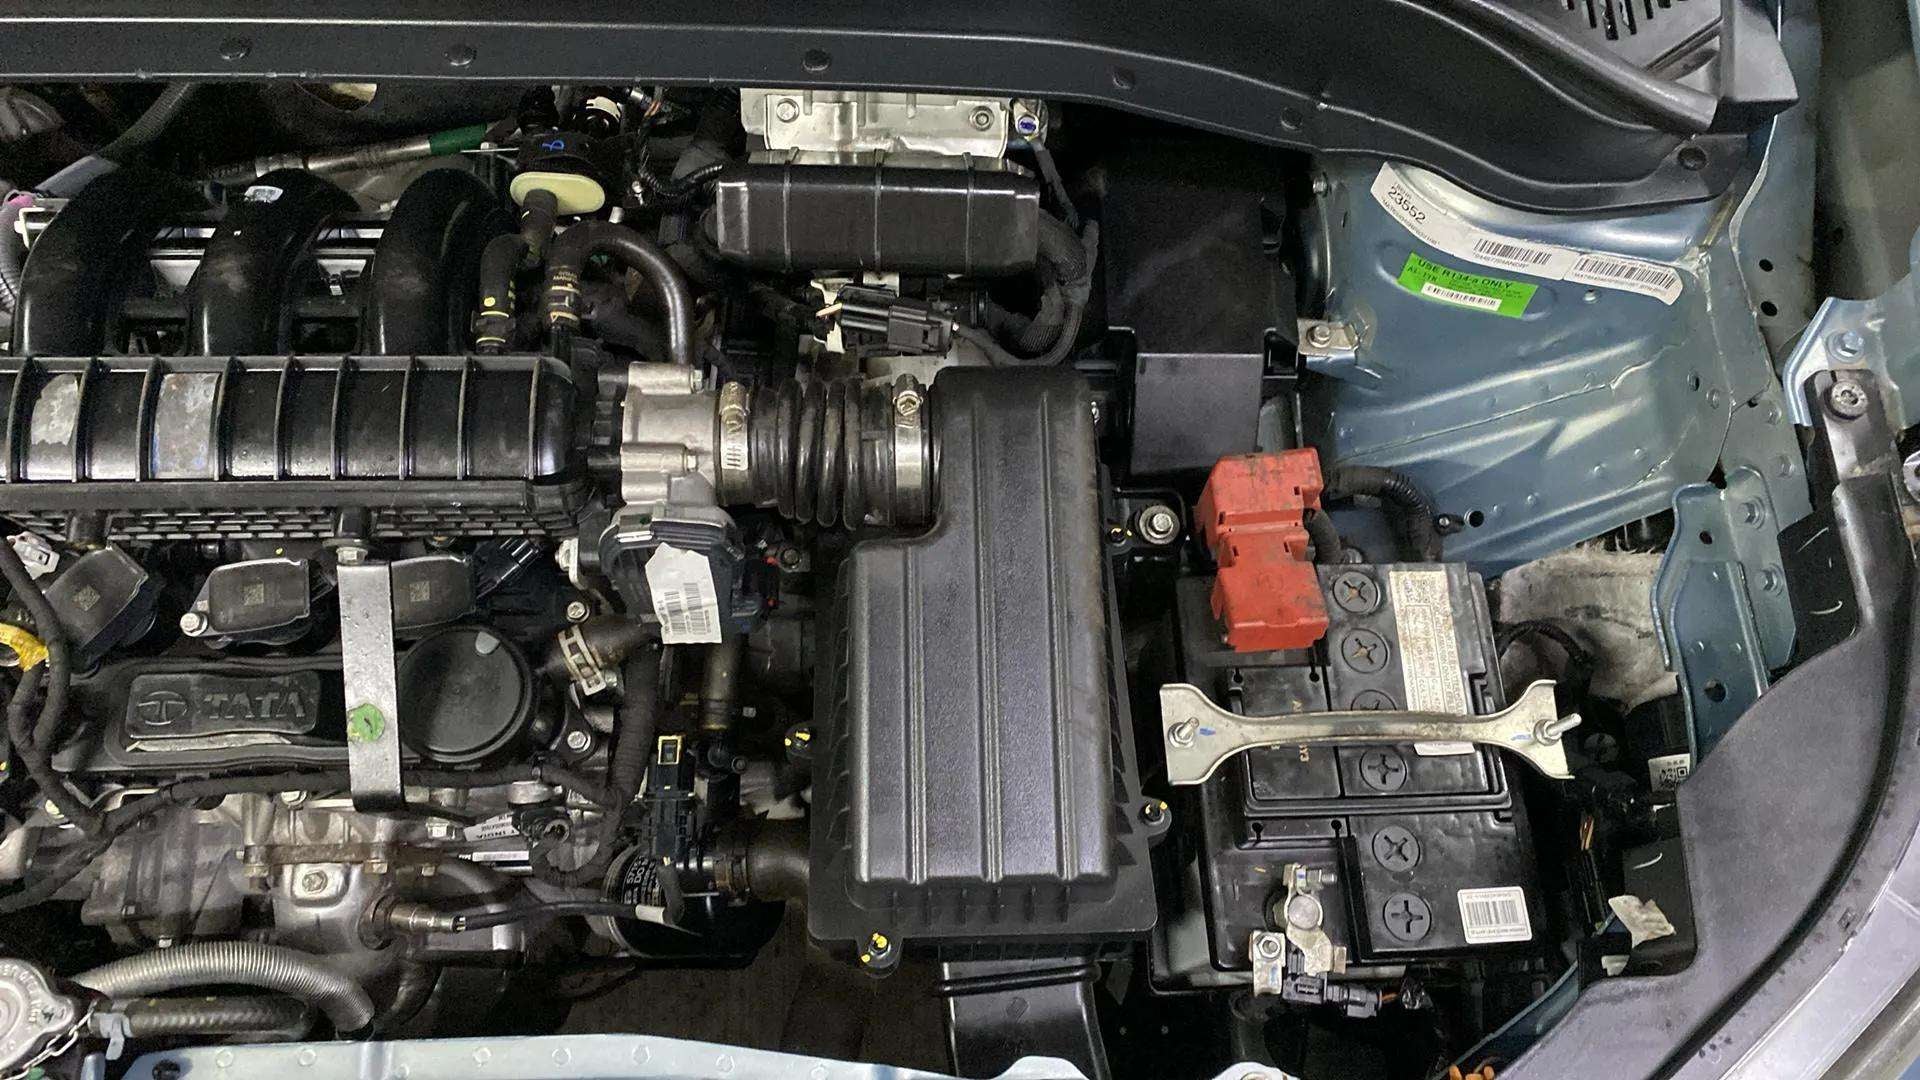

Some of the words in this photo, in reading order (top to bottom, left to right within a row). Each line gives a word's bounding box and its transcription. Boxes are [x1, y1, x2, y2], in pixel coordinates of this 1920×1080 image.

[1387, 186, 1426, 225] 23552
[1418, 259, 1440, 272] USE
[1481, 278, 1513, 289] ONLY
[203, 692, 306, 719] TATA
